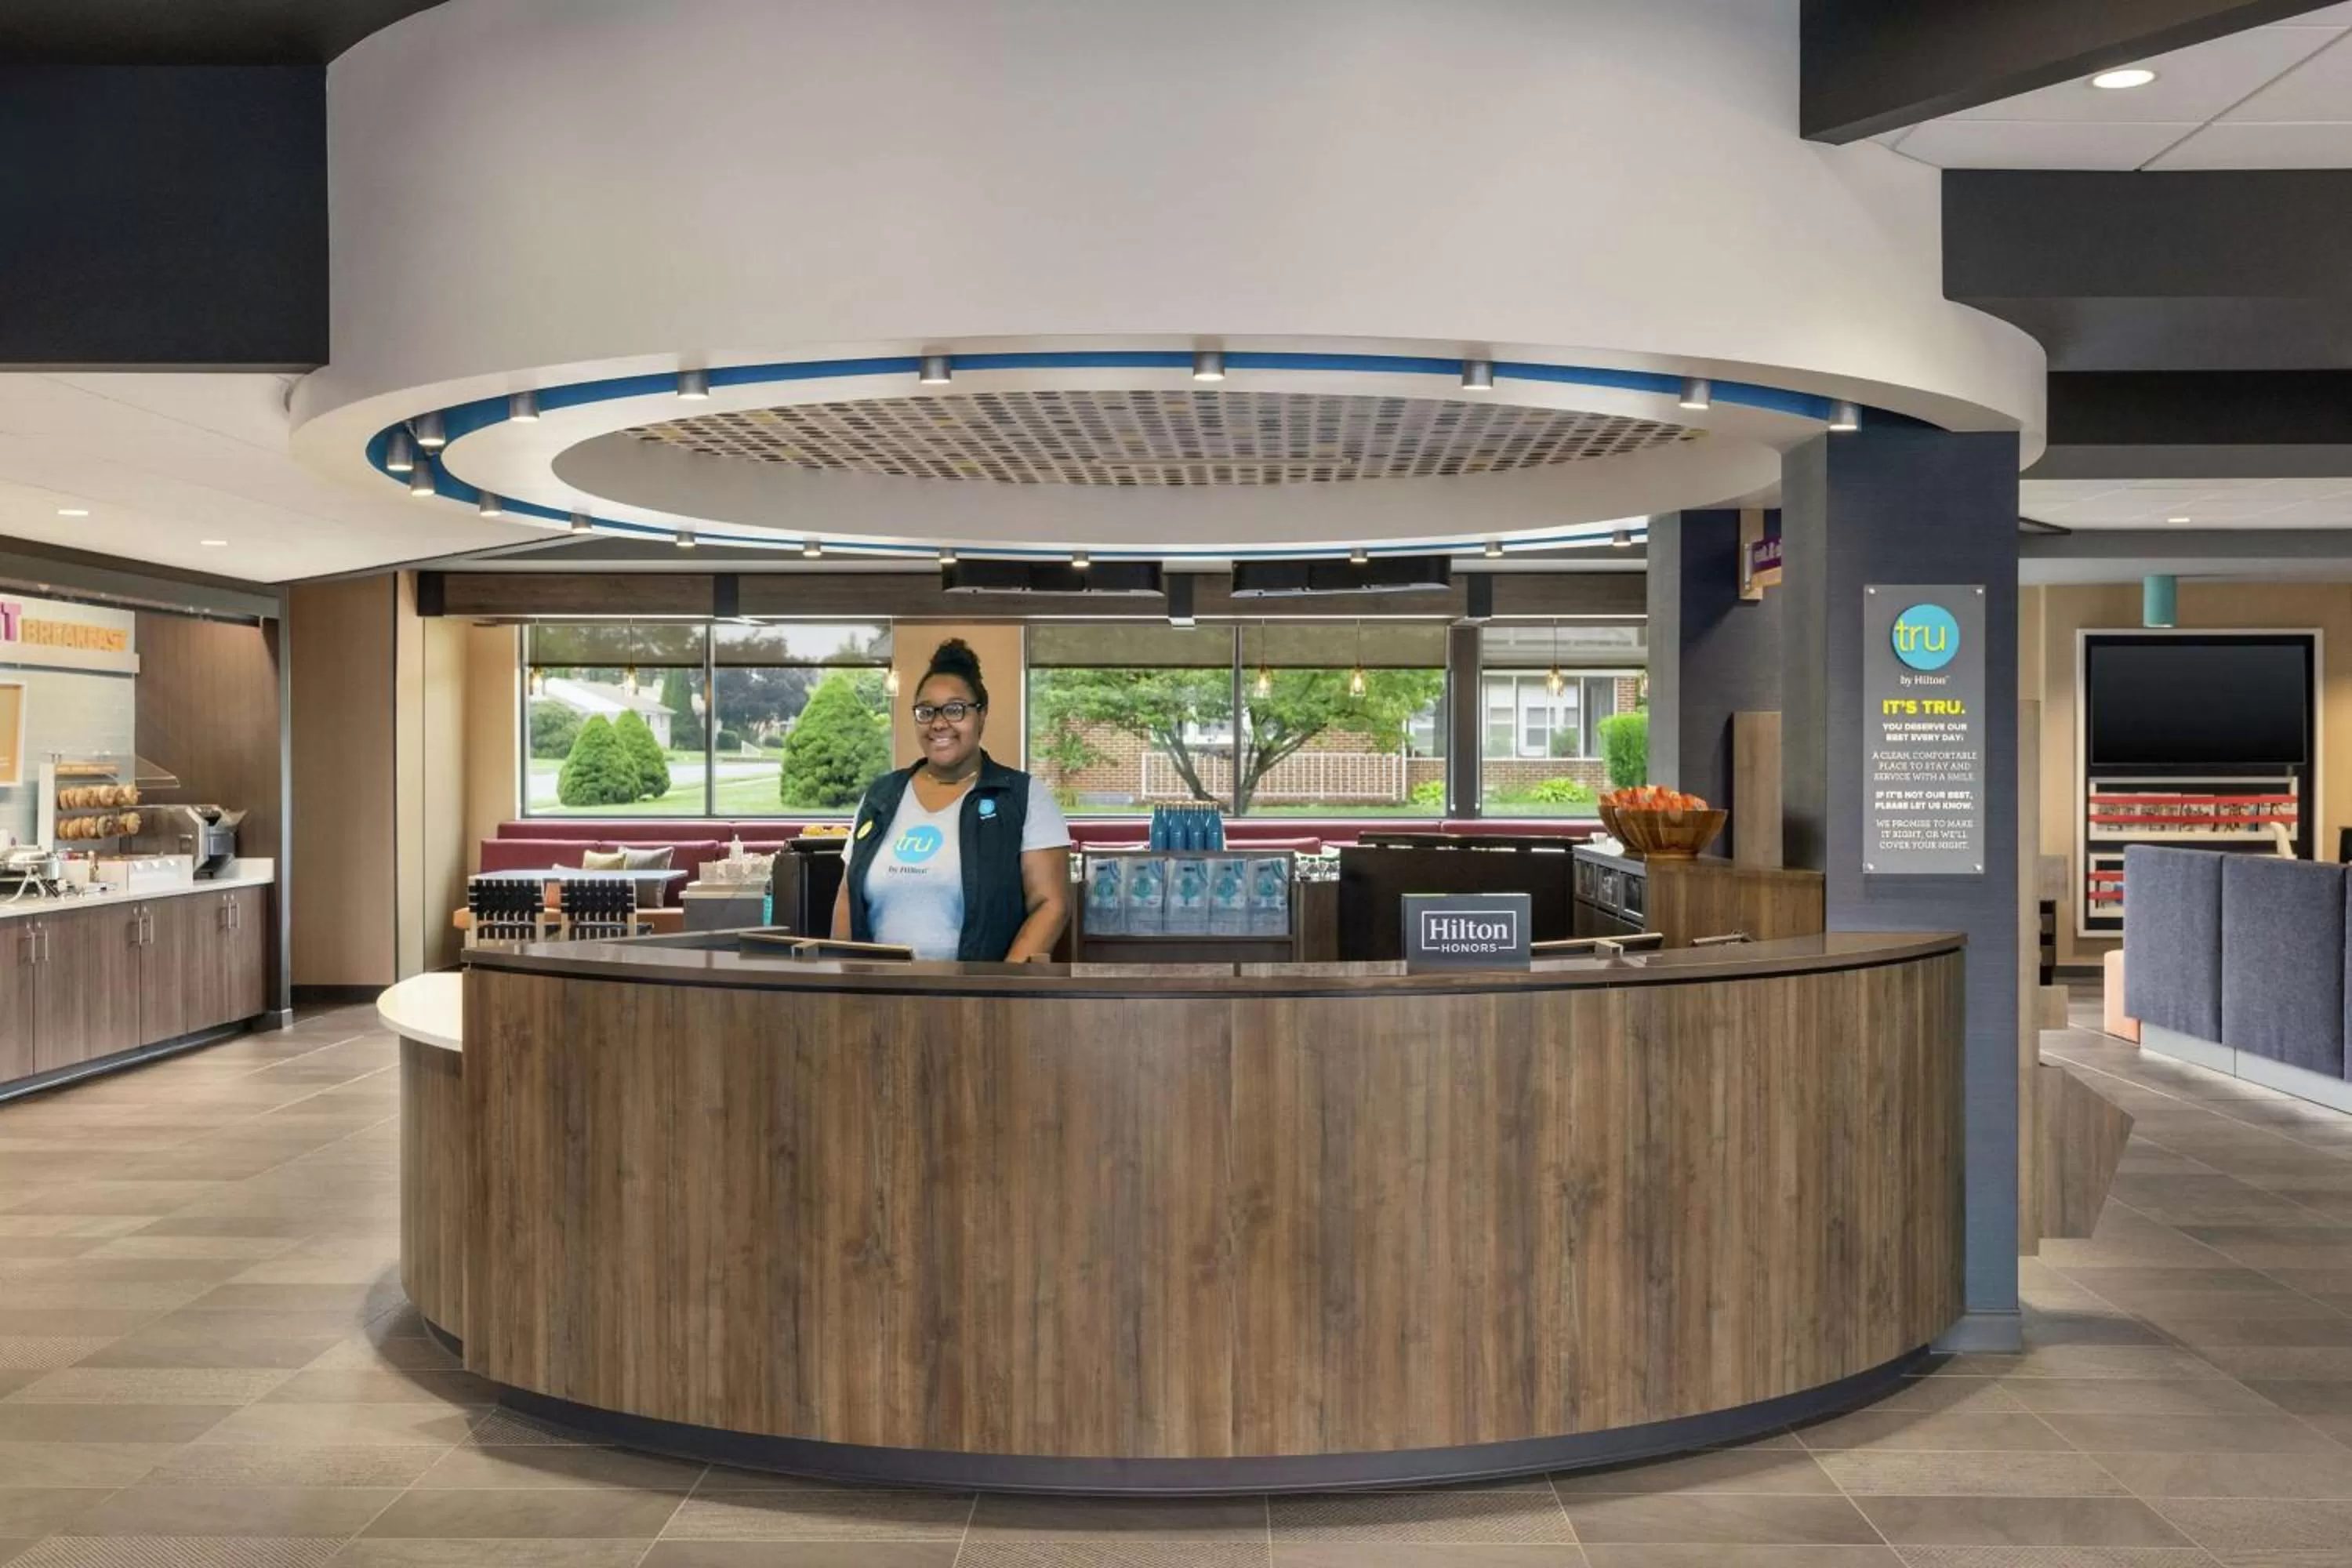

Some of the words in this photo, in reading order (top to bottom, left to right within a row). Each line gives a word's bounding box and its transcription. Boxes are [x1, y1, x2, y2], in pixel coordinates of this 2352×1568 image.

[1895, 618, 1945, 652] tru
[1900, 675, 1911, 687] by
[1882, 699, 1918, 714] IT'S
[1922, 699, 1965, 714] TRU.
[1871, 751, 1879, 760] A
[1912, 751, 1976, 760] COMFORTABLE
[1878, 761, 1907, 770] PLACE
[1909, 761, 1923, 770] TO
[1925, 761, 1948, 770] STAY
[1949, 761, 1971, 770] AND
[1873, 772, 1911, 781] SERVICE
[1912, 772, 1936, 781] WITH
[1939, 772, 1945, 781] A
[895, 830, 934, 852] tru
[1429, 918, 1508, 940] Hilton
[1441, 943, 1497, 953] HONORS
